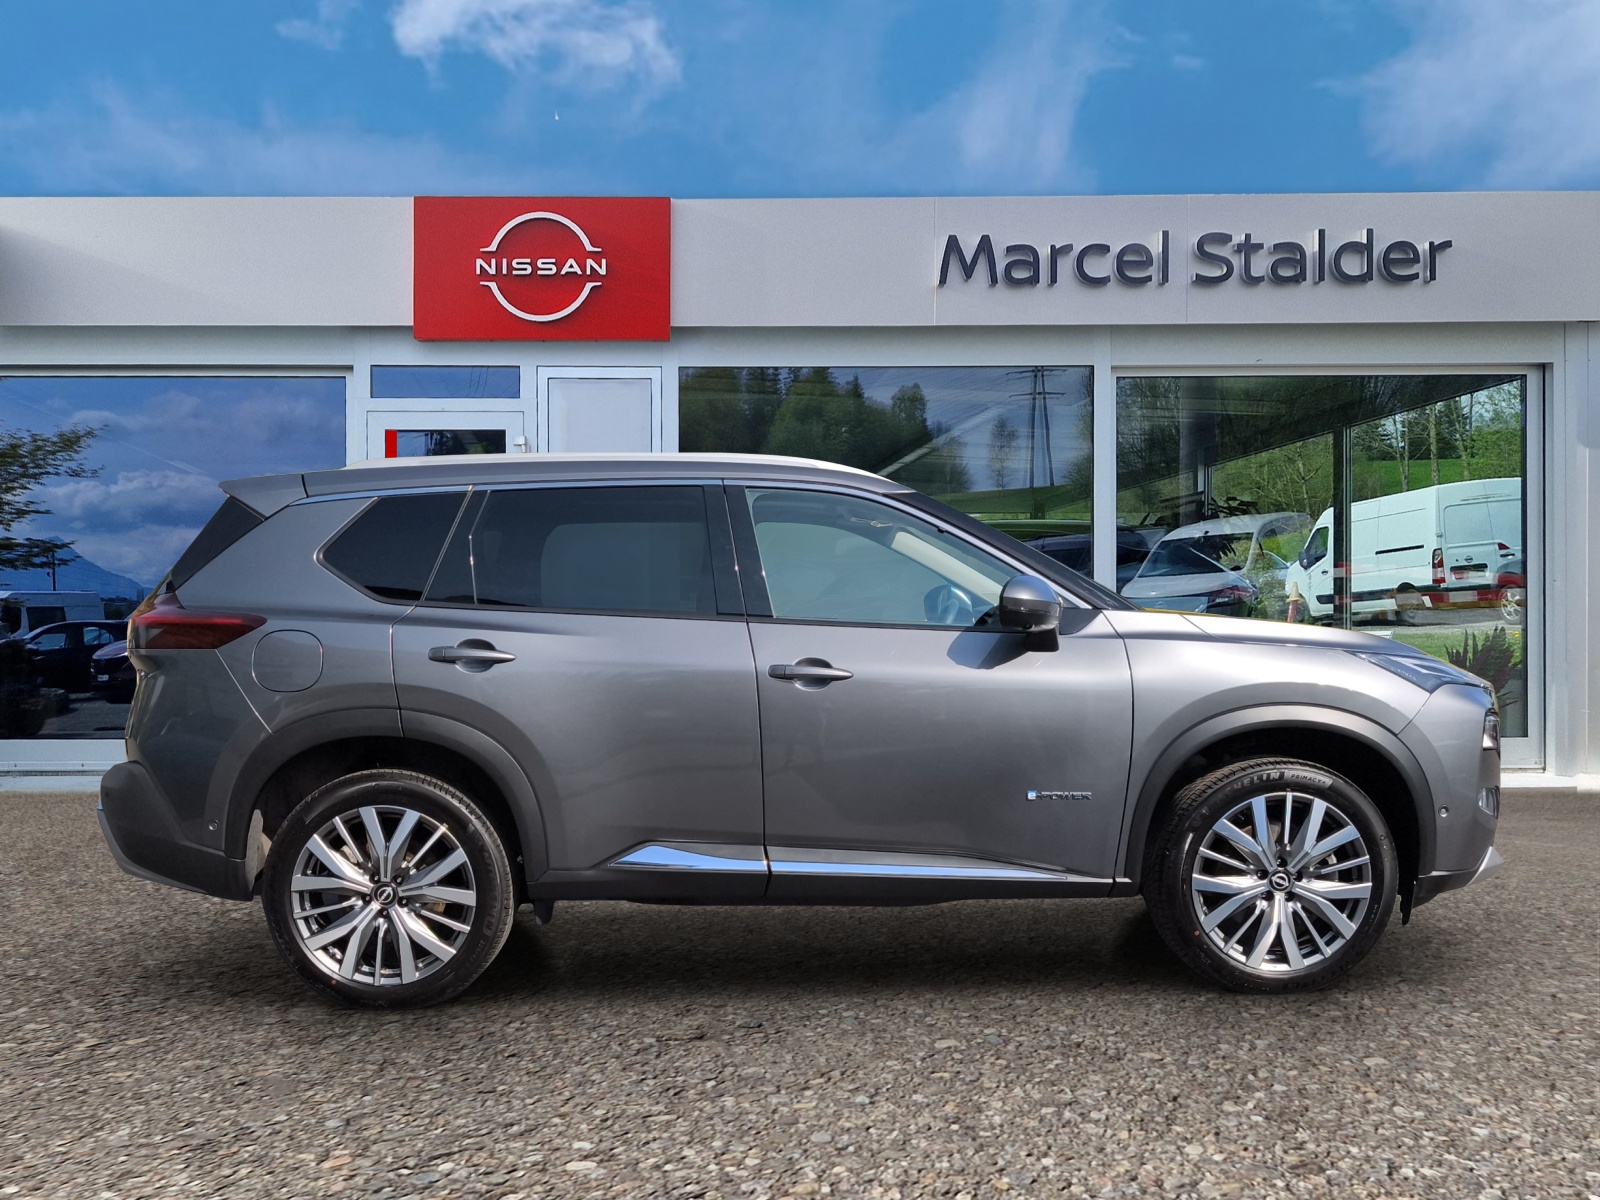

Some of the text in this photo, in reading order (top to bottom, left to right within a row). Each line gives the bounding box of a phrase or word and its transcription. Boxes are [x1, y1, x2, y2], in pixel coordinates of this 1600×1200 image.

[475, 258, 607, 276] NISSAN
[937, 228, 1453, 287] Marcel Stalder
